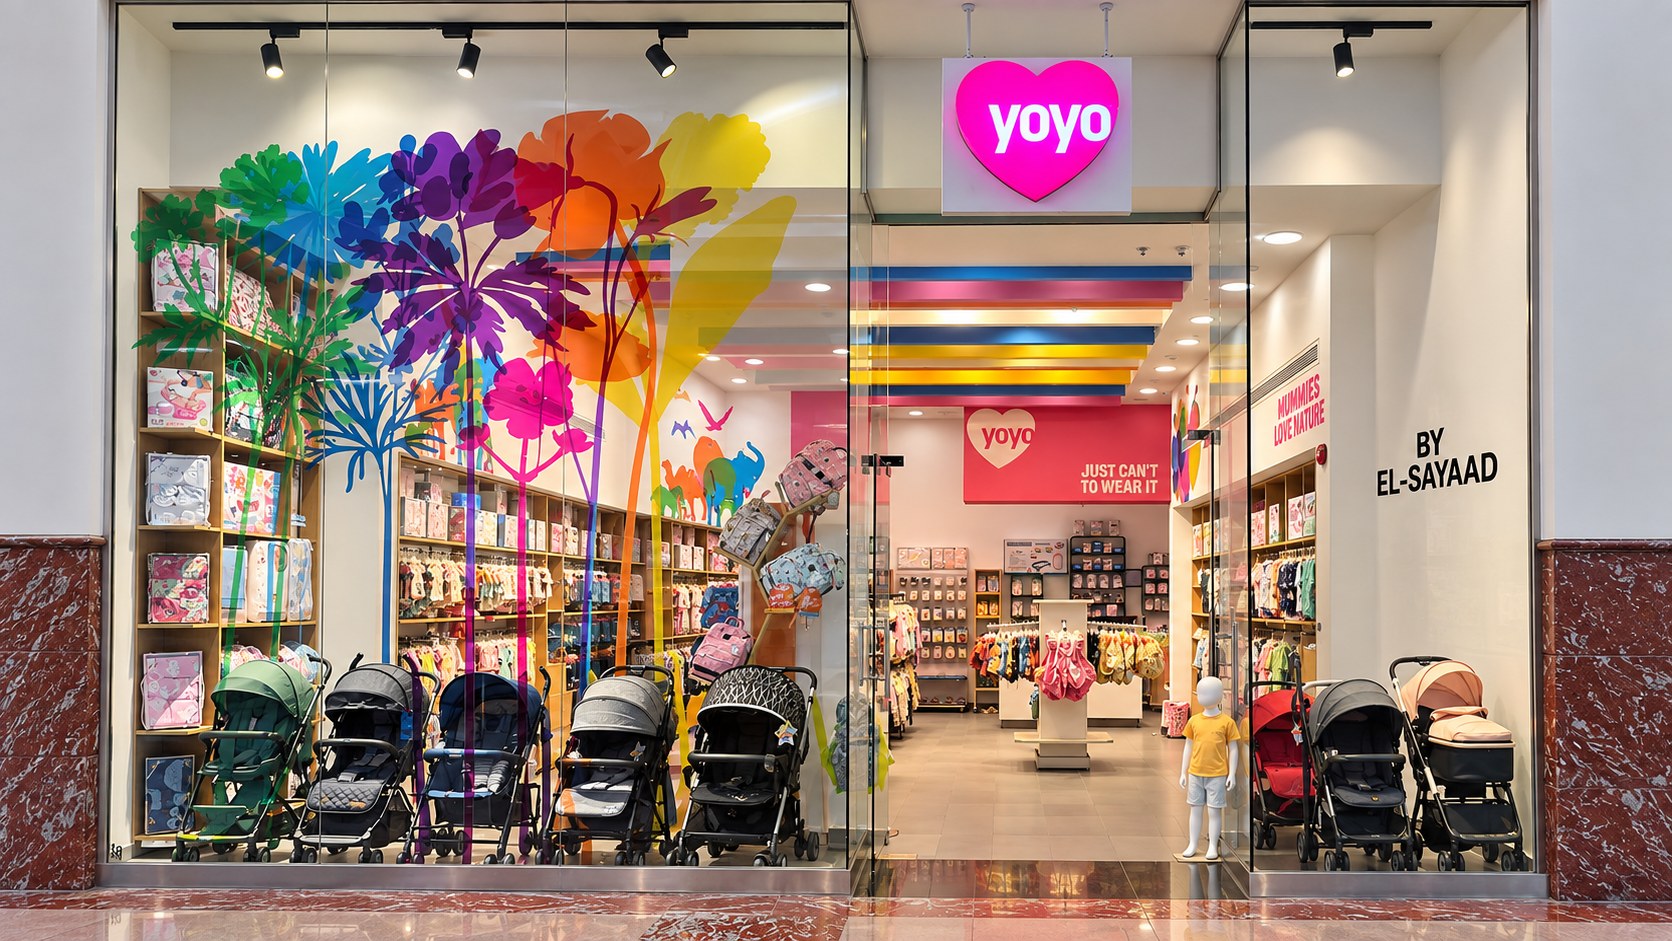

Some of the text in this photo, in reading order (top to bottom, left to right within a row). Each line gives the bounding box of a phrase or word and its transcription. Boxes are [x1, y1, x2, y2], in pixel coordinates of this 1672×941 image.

[988, 104, 1112, 154] yoyo
[1278, 373, 1320, 420] MUMMIES
[981, 427, 1035, 450] yoyo
[1274, 398, 1325, 447] LOVE NATURE
[1416, 427, 1445, 459] BY
[1080, 479, 1159, 494] TO WEAR IT
[1081, 463, 1159, 478] JUST CAN'T
[1377, 451, 1498, 497] EL-SAYAAD
